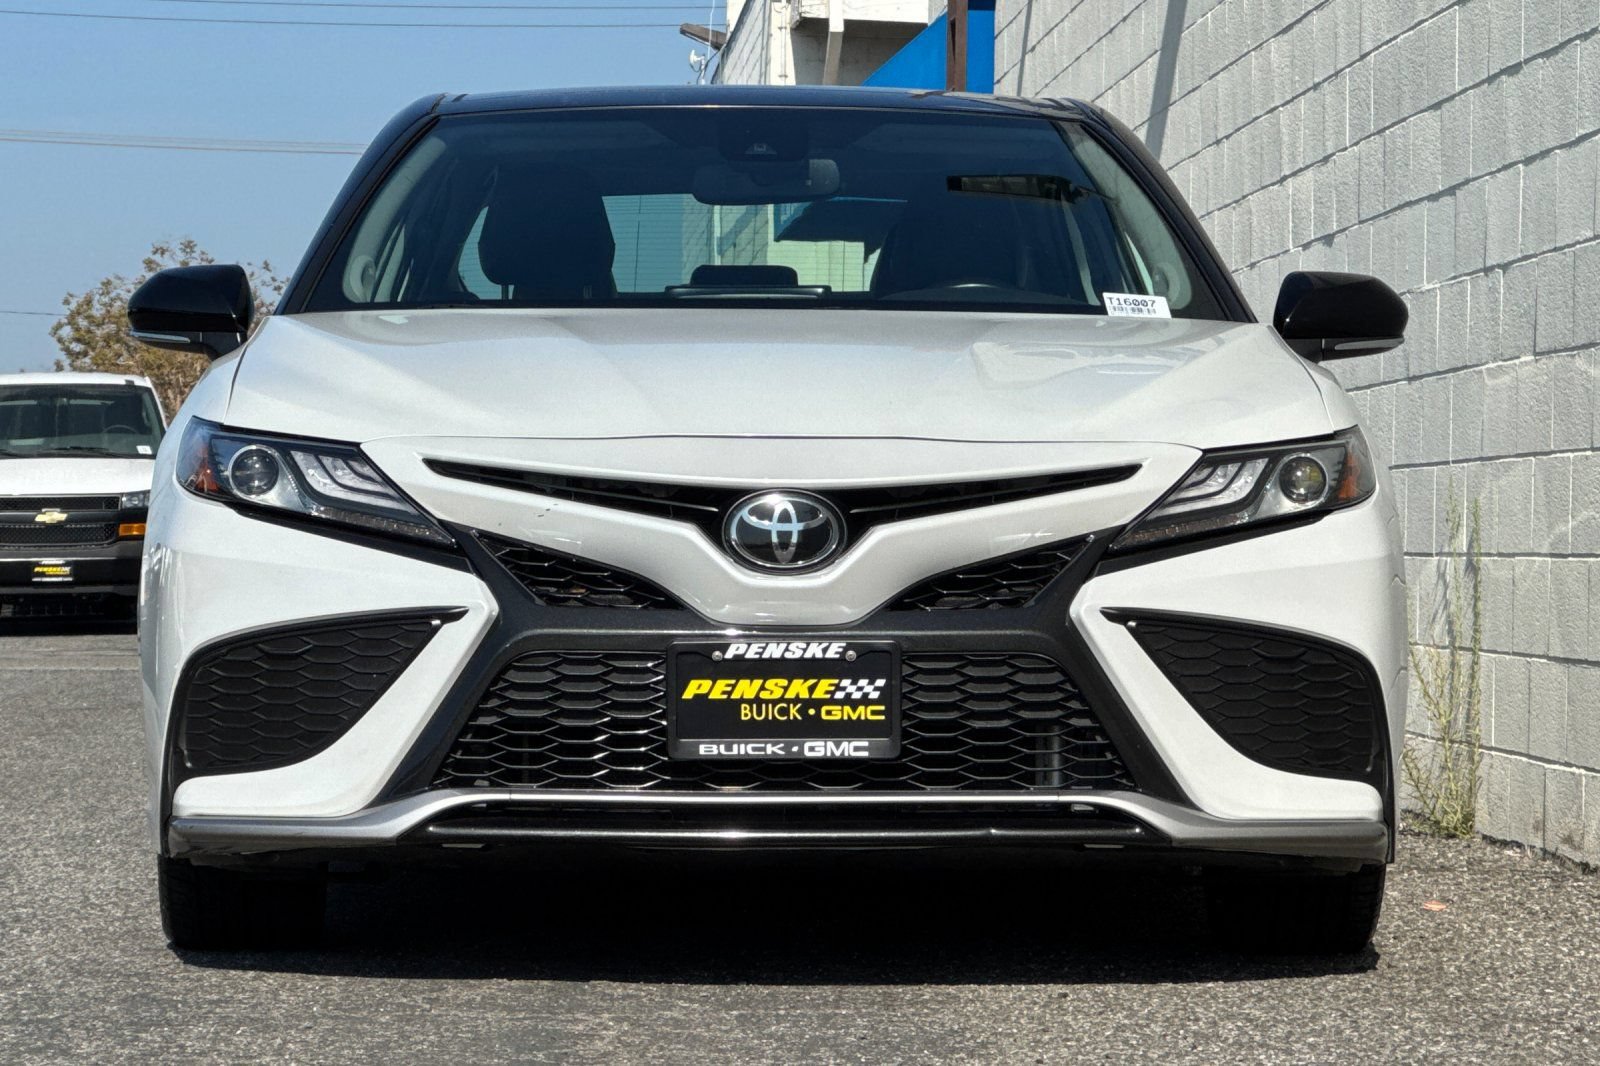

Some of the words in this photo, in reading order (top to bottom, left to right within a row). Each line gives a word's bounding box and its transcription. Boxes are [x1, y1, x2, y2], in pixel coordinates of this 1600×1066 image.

[1106, 297, 1156, 308] T16007
[724, 642, 846, 659] PENSKE
[681, 679, 840, 699] PENSKE
[740, 704, 802, 720] BUICK
[821, 705, 886, 720] GMC
[699, 743, 785, 755] BUICK
[804, 741, 869, 757] GMC
